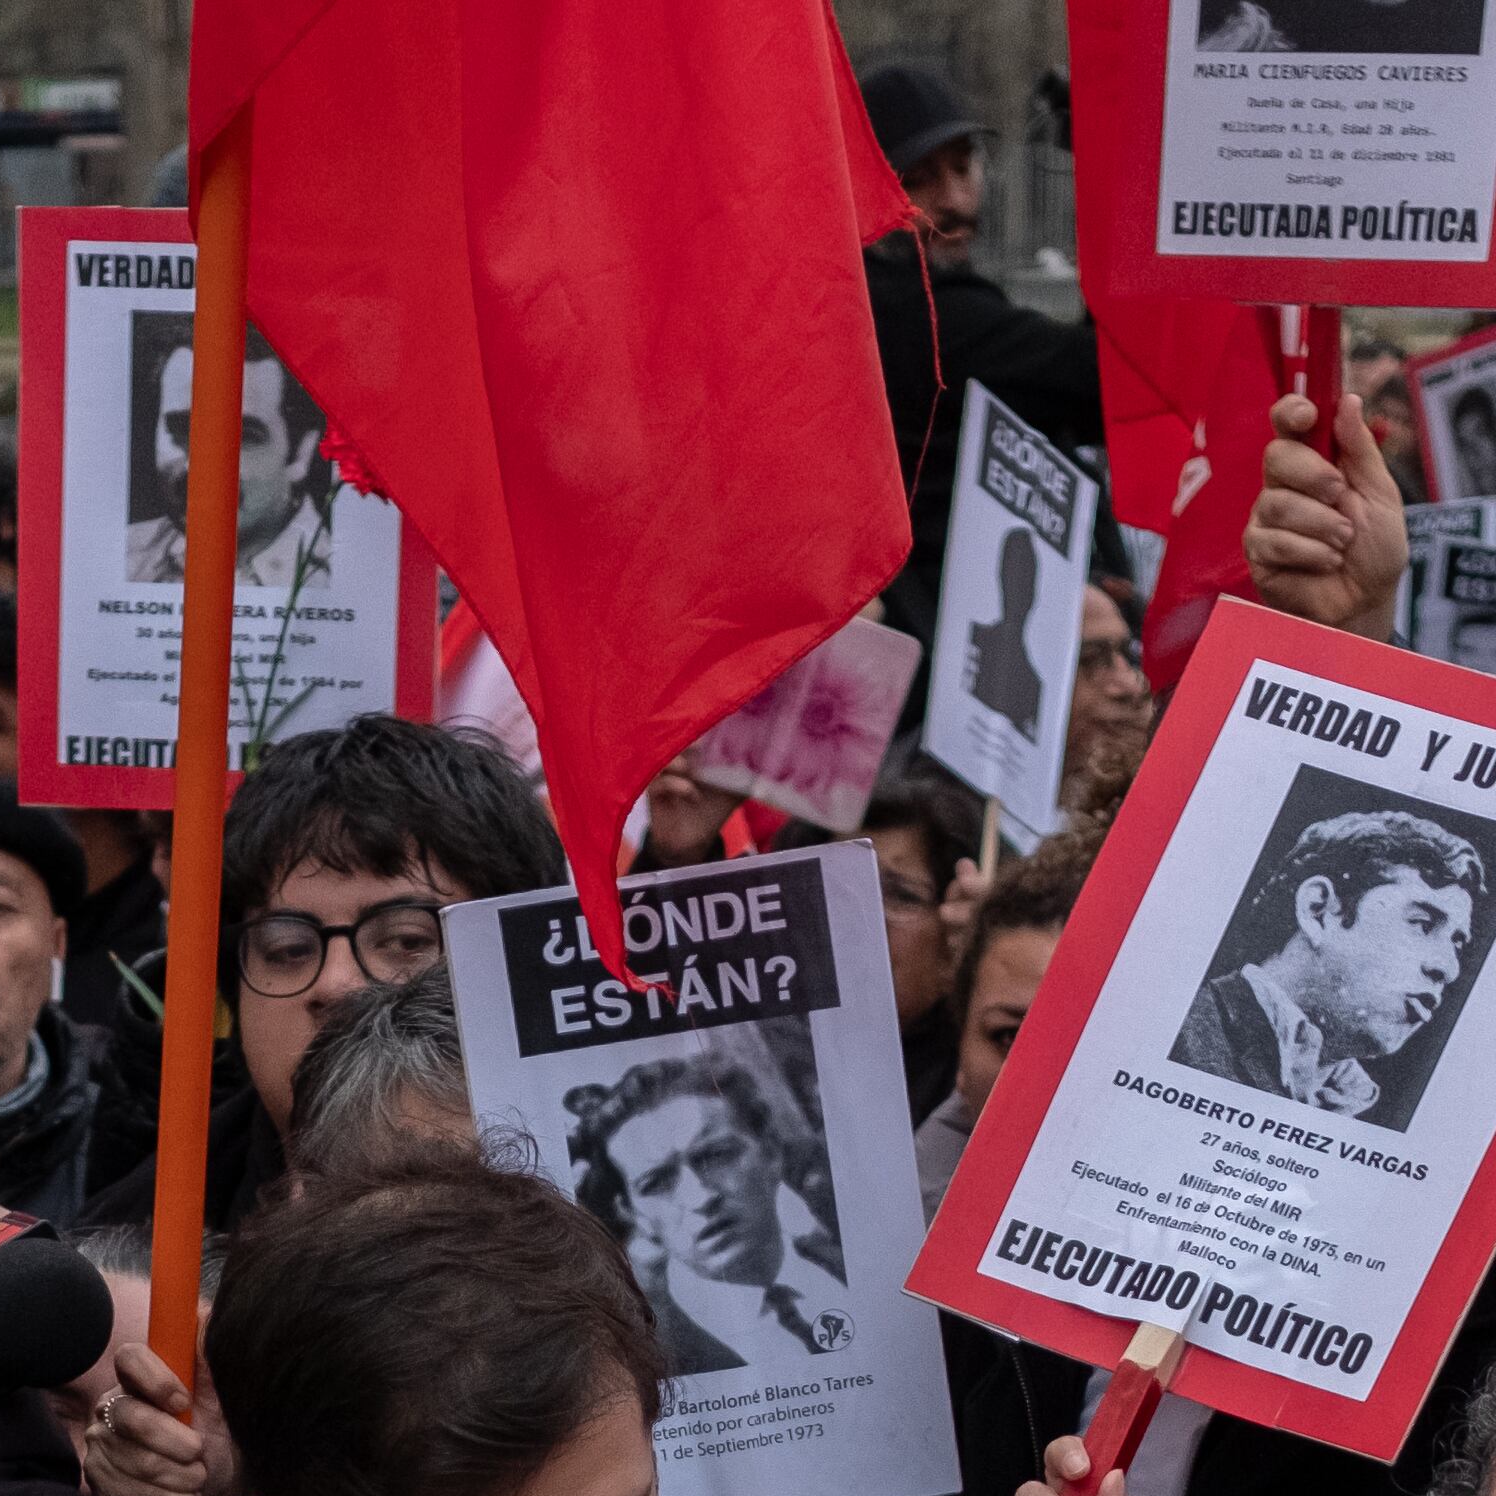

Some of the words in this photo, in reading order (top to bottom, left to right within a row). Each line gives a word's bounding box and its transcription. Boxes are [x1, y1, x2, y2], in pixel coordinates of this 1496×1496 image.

[1193, 63, 1249, 79] MARIA
[1258, 64, 1367, 81] CIENFUEGOS
[1376, 65, 1470, 83] CAVIERES
[1173, 201, 1332, 240] EJECUTADA
[1340, 200, 1478, 244] POLÍTICA
[75, 253, 194, 289] VERDAD
[98, 600, 174, 615] NELSON
[87, 667, 157, 682] Ejecutado
[1243, 676, 1402, 760] VERDAD
[1420, 730, 1452, 773] Y
[550, 953, 798, 1035] ESTÁN?
[1112, 1069, 1256, 1130] DAGOBERTO
[1258, 1117, 1334, 1155] PEREZ
[1339, 1140, 1430, 1183] VARGAS
[1199, 1131, 1220, 1148] 27
[1221, 1137, 1262, 1163] años,
[1265, 1150, 1320, 1180] soltero
[1212, 1158, 1288, 1194] Sociólogo
[1070, 1158, 1149, 1198] Ejecutado
[1155, 1189, 1172, 1206] el
[1174, 1193, 1192, 1211] 16
[1193, 1199, 1210, 1215] de
[1213, 1205, 1276, 1237] Octubre
[1278, 1226, 1299, 1245] de
[1302, 1234, 1340, 1261] 1975,
[1342, 1249, 1363, 1264] en
[1365, 1256, 1386, 1273] un
[1178, 1172, 1242, 1203] Militante
[1243, 1192, 1268, 1209] del
[1269, 1199, 1304, 1223] MIR
[1114, 1199, 1227, 1242] Enfrentamiento
[1228, 1234, 1260, 1256] con
[1261, 1246, 1278, 1263] la
[1279, 1251, 1322, 1279] DINA.
[1176, 1238, 1237, 1271] Malloco
[995, 1217, 1201, 1313] EJECUTADO
[1196, 1287, 1375, 1377] POLÍTICO
[678, 1389, 761, 1416] Bartolomé
[764, 1382, 821, 1402] Blanco
[823, 1373, 875, 1392] Tarres
[653, 1420, 713, 1442] etenido
[716, 1417, 744, 1436] por
[746, 1401, 836, 1428] carabineros
[673, 1444, 694, 1460] de
[697, 1430, 784, 1459] Septiembre
[787, 1422, 825, 1441] 1973
